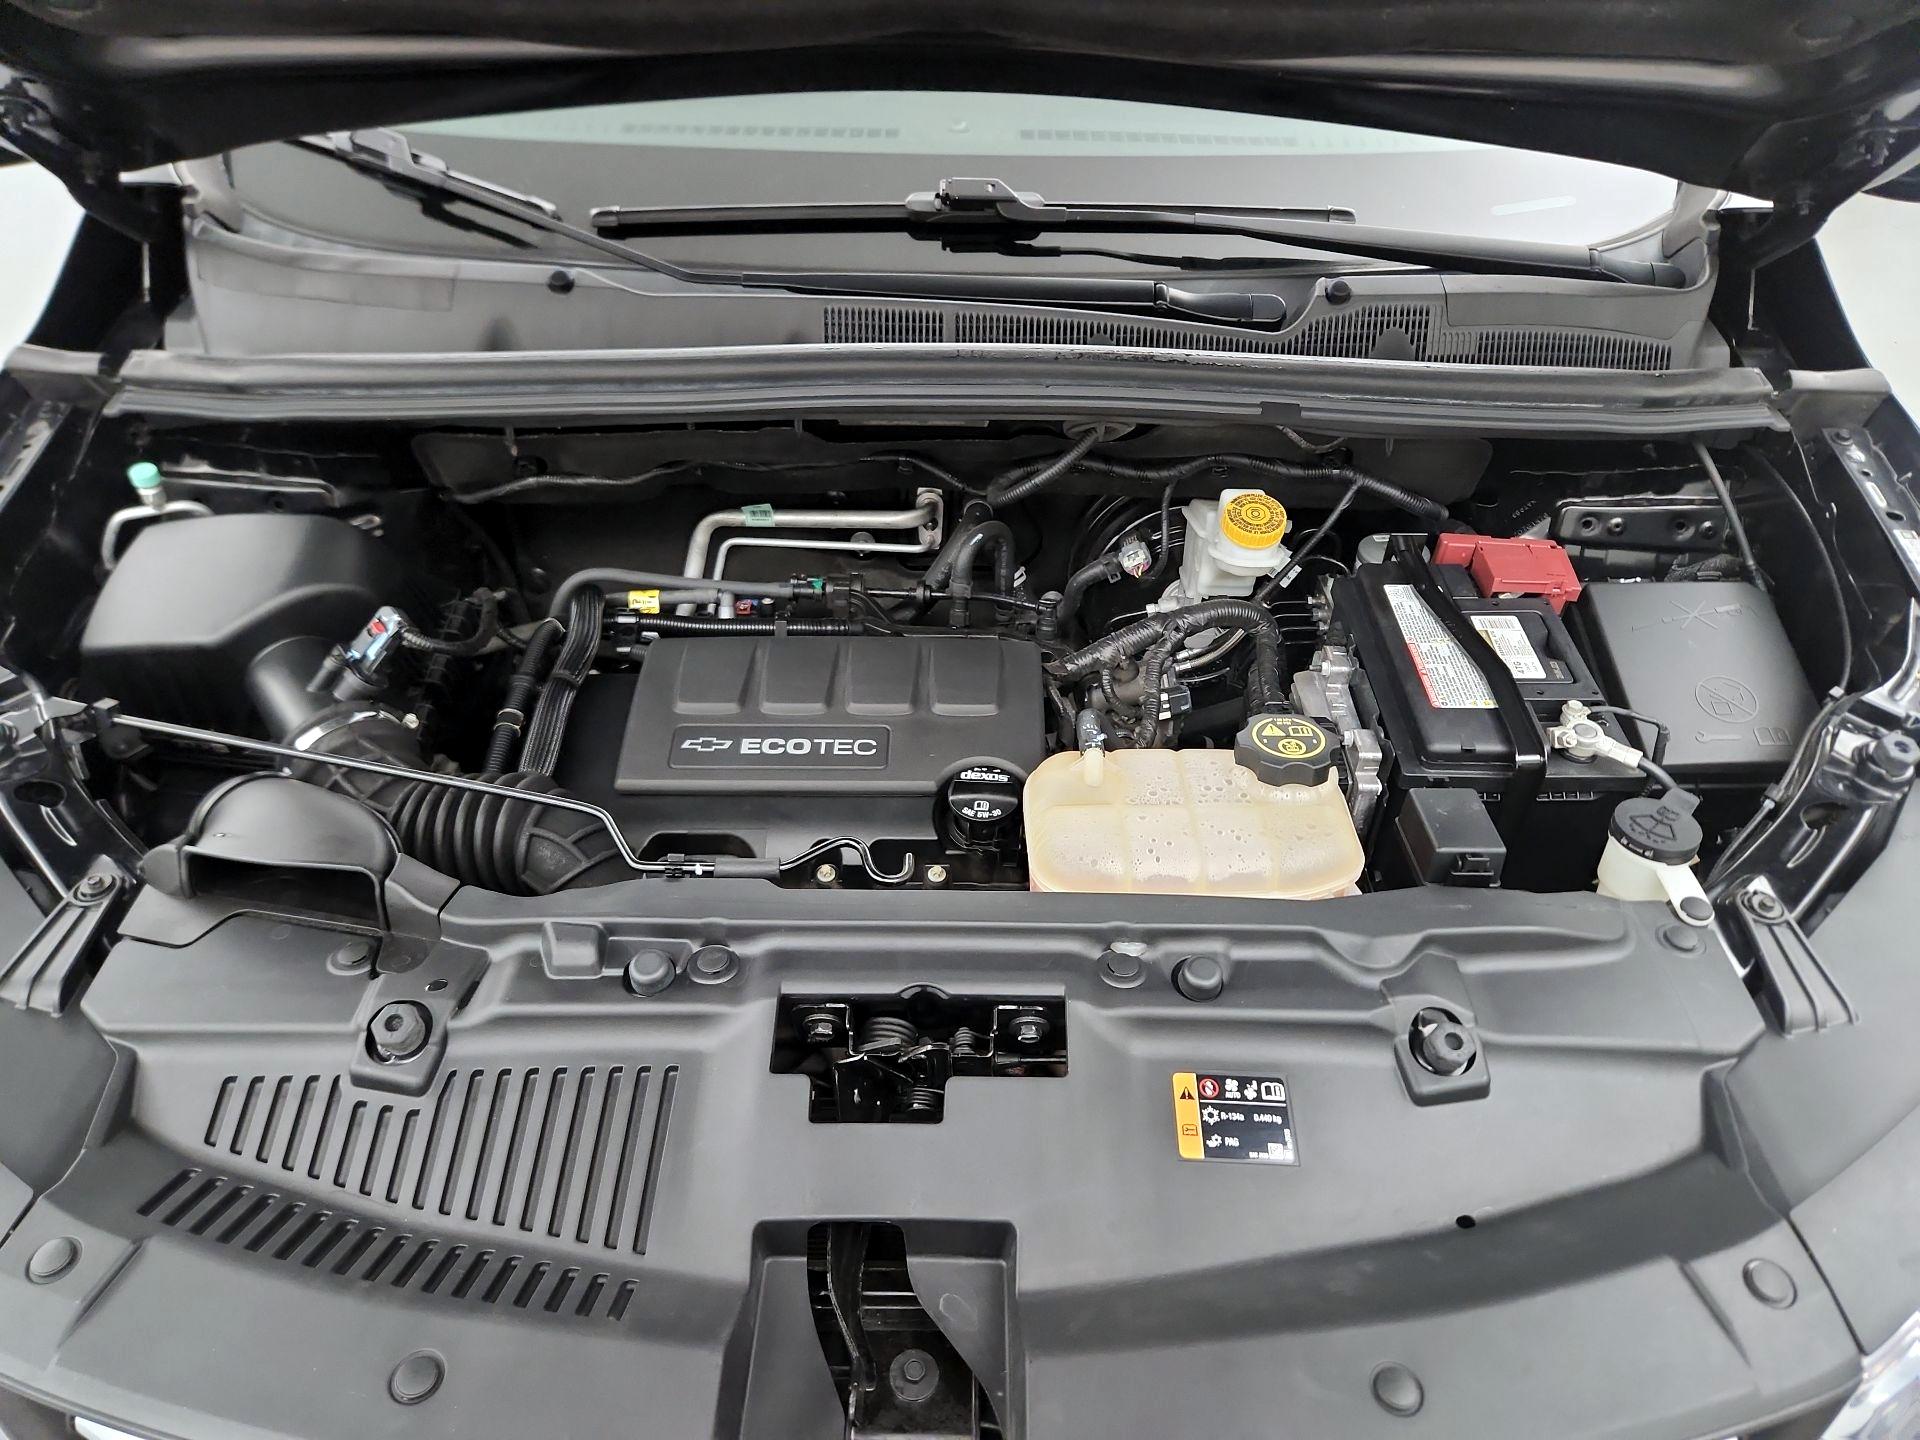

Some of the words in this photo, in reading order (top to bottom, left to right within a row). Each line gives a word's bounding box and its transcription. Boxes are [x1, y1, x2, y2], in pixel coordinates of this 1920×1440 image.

[740, 738, 877, 755] ECOTEC
[960, 770, 1009, 782] dexos
[962, 807, 976, 817] SAE
[977, 809, 1002, 818] 5W-30
[1225, 1091, 1241, 1099] AUTO
[1224, 1137, 1239, 1148] PAG
